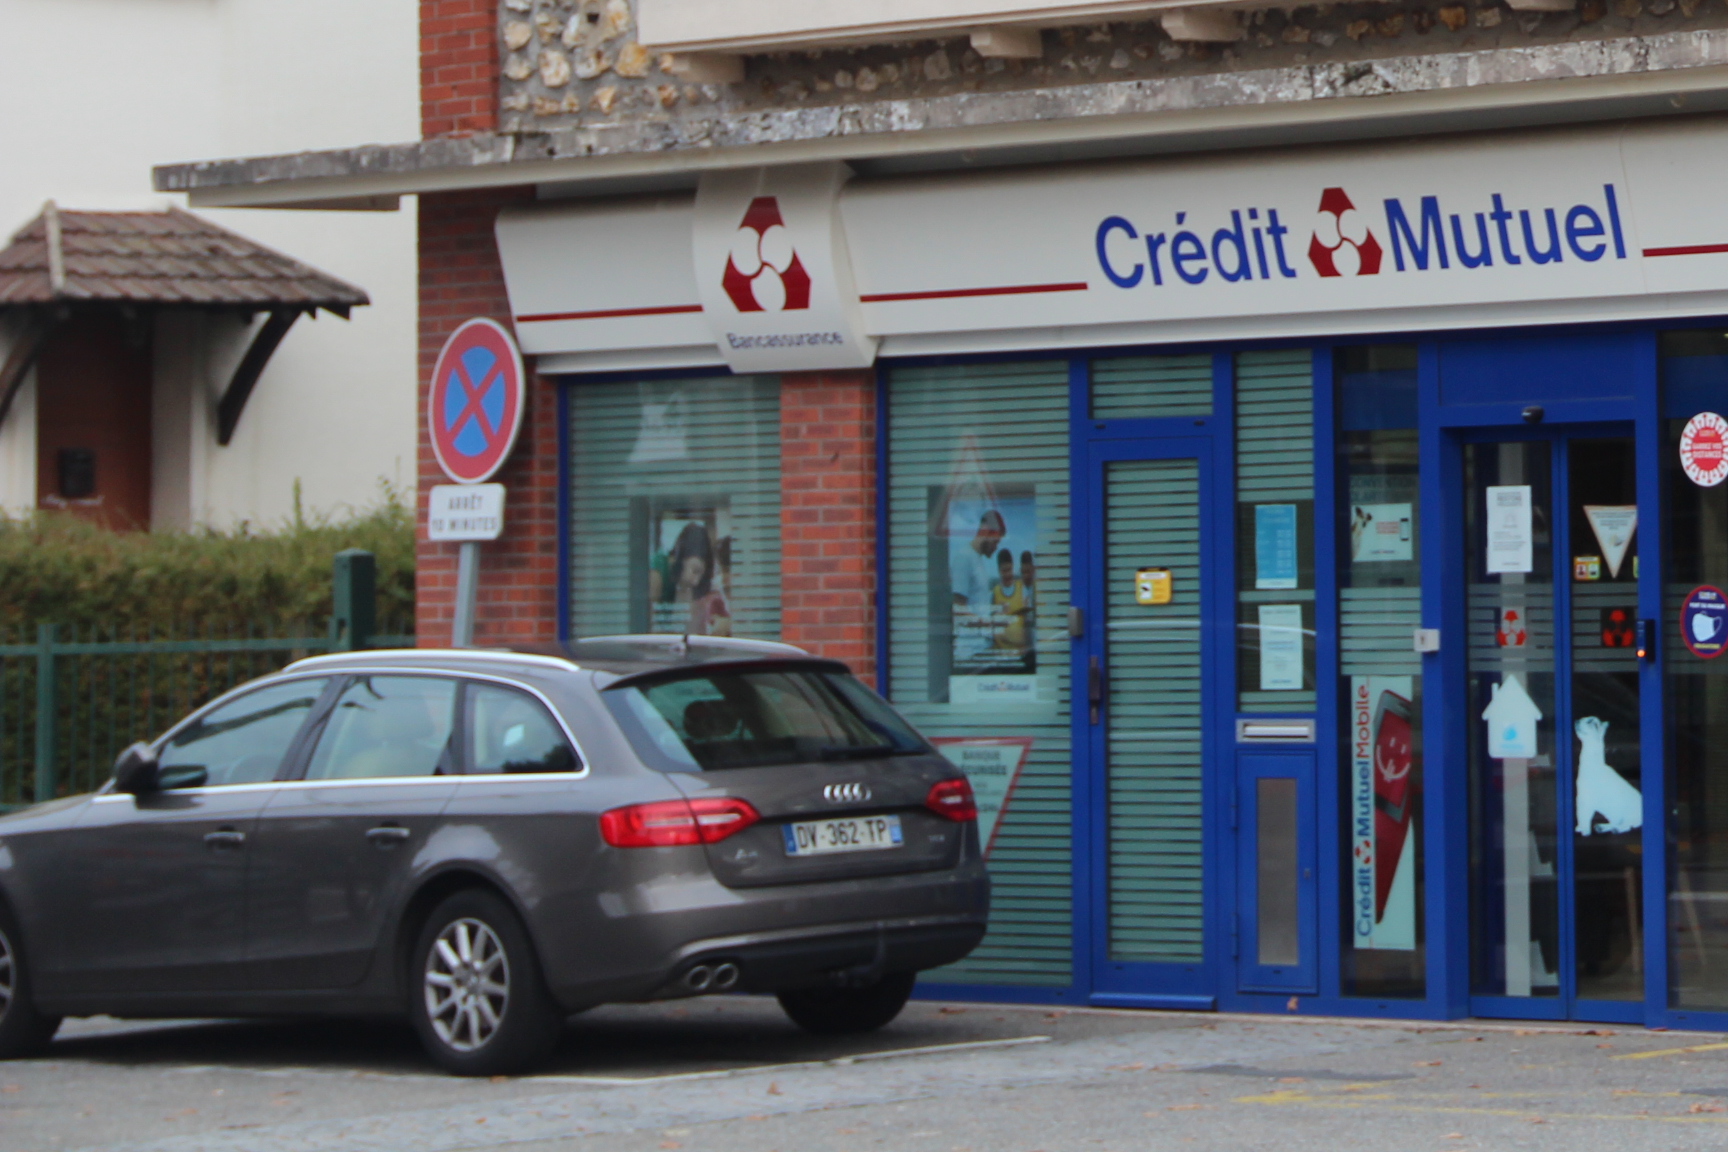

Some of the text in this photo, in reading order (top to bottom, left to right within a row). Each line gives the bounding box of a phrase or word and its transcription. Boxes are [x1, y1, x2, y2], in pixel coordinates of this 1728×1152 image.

[1096, 183, 1626, 289] Crédit Mutuel
[726, 332, 843, 348] Bancassurance
[449, 517, 497, 531] MINUTES
[1357, 868, 1371, 936] Crédit
